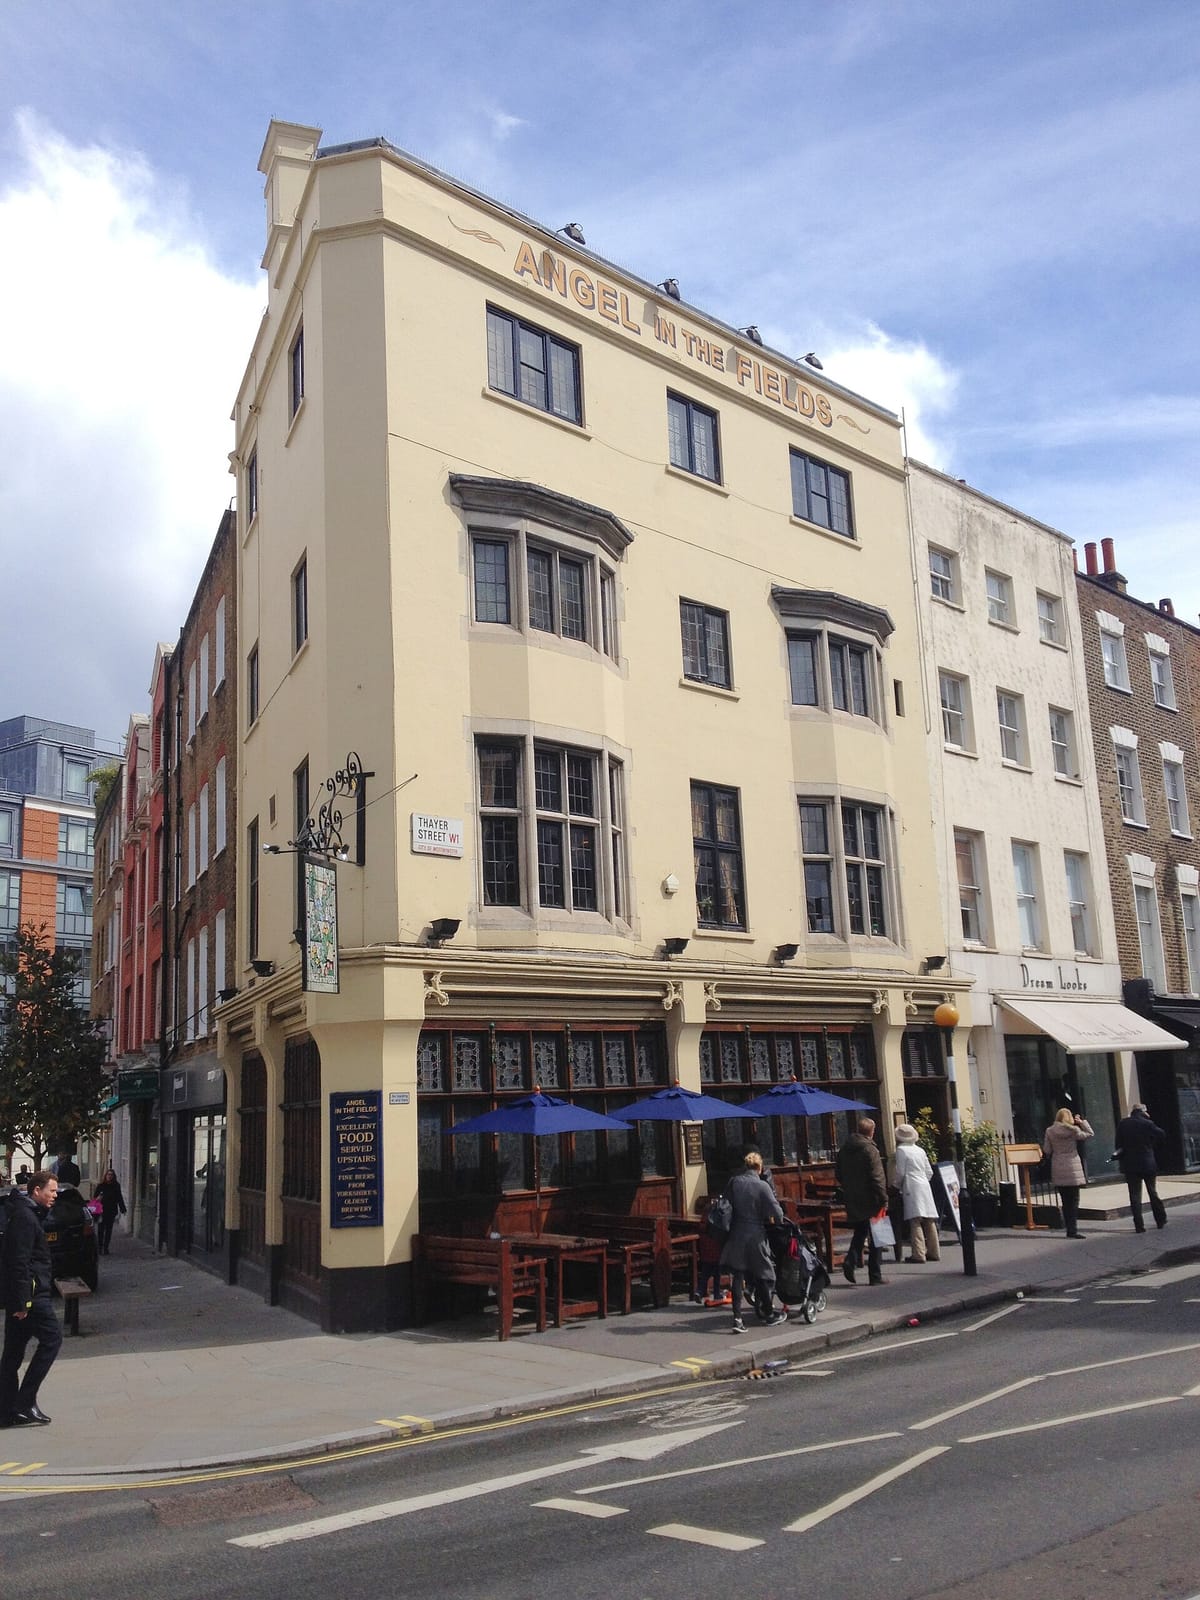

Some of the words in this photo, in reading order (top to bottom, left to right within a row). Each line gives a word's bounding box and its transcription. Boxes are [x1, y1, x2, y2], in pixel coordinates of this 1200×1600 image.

[514, 241, 640, 334] ANGEL
[654, 313, 676, 348] IN
[682, 329, 724, 372] THE
[736, 350, 832, 428] FIELDS
[418, 817, 448, 830] THAYER
[418, 829, 446, 842] STREET
[449, 833, 459, 844] W1
[1020, 963, 1053, 988] Dream
[1058, 966, 1087, 991] Looks
[356, 1105, 377, 1113] FIELDS
[336, 1122, 376, 1131] EXCELLENT
[339, 1131, 374, 1144] FOOD
[340, 1145, 372, 1153] SERVED
[337, 1155, 376, 1164] UPSTAIRS
